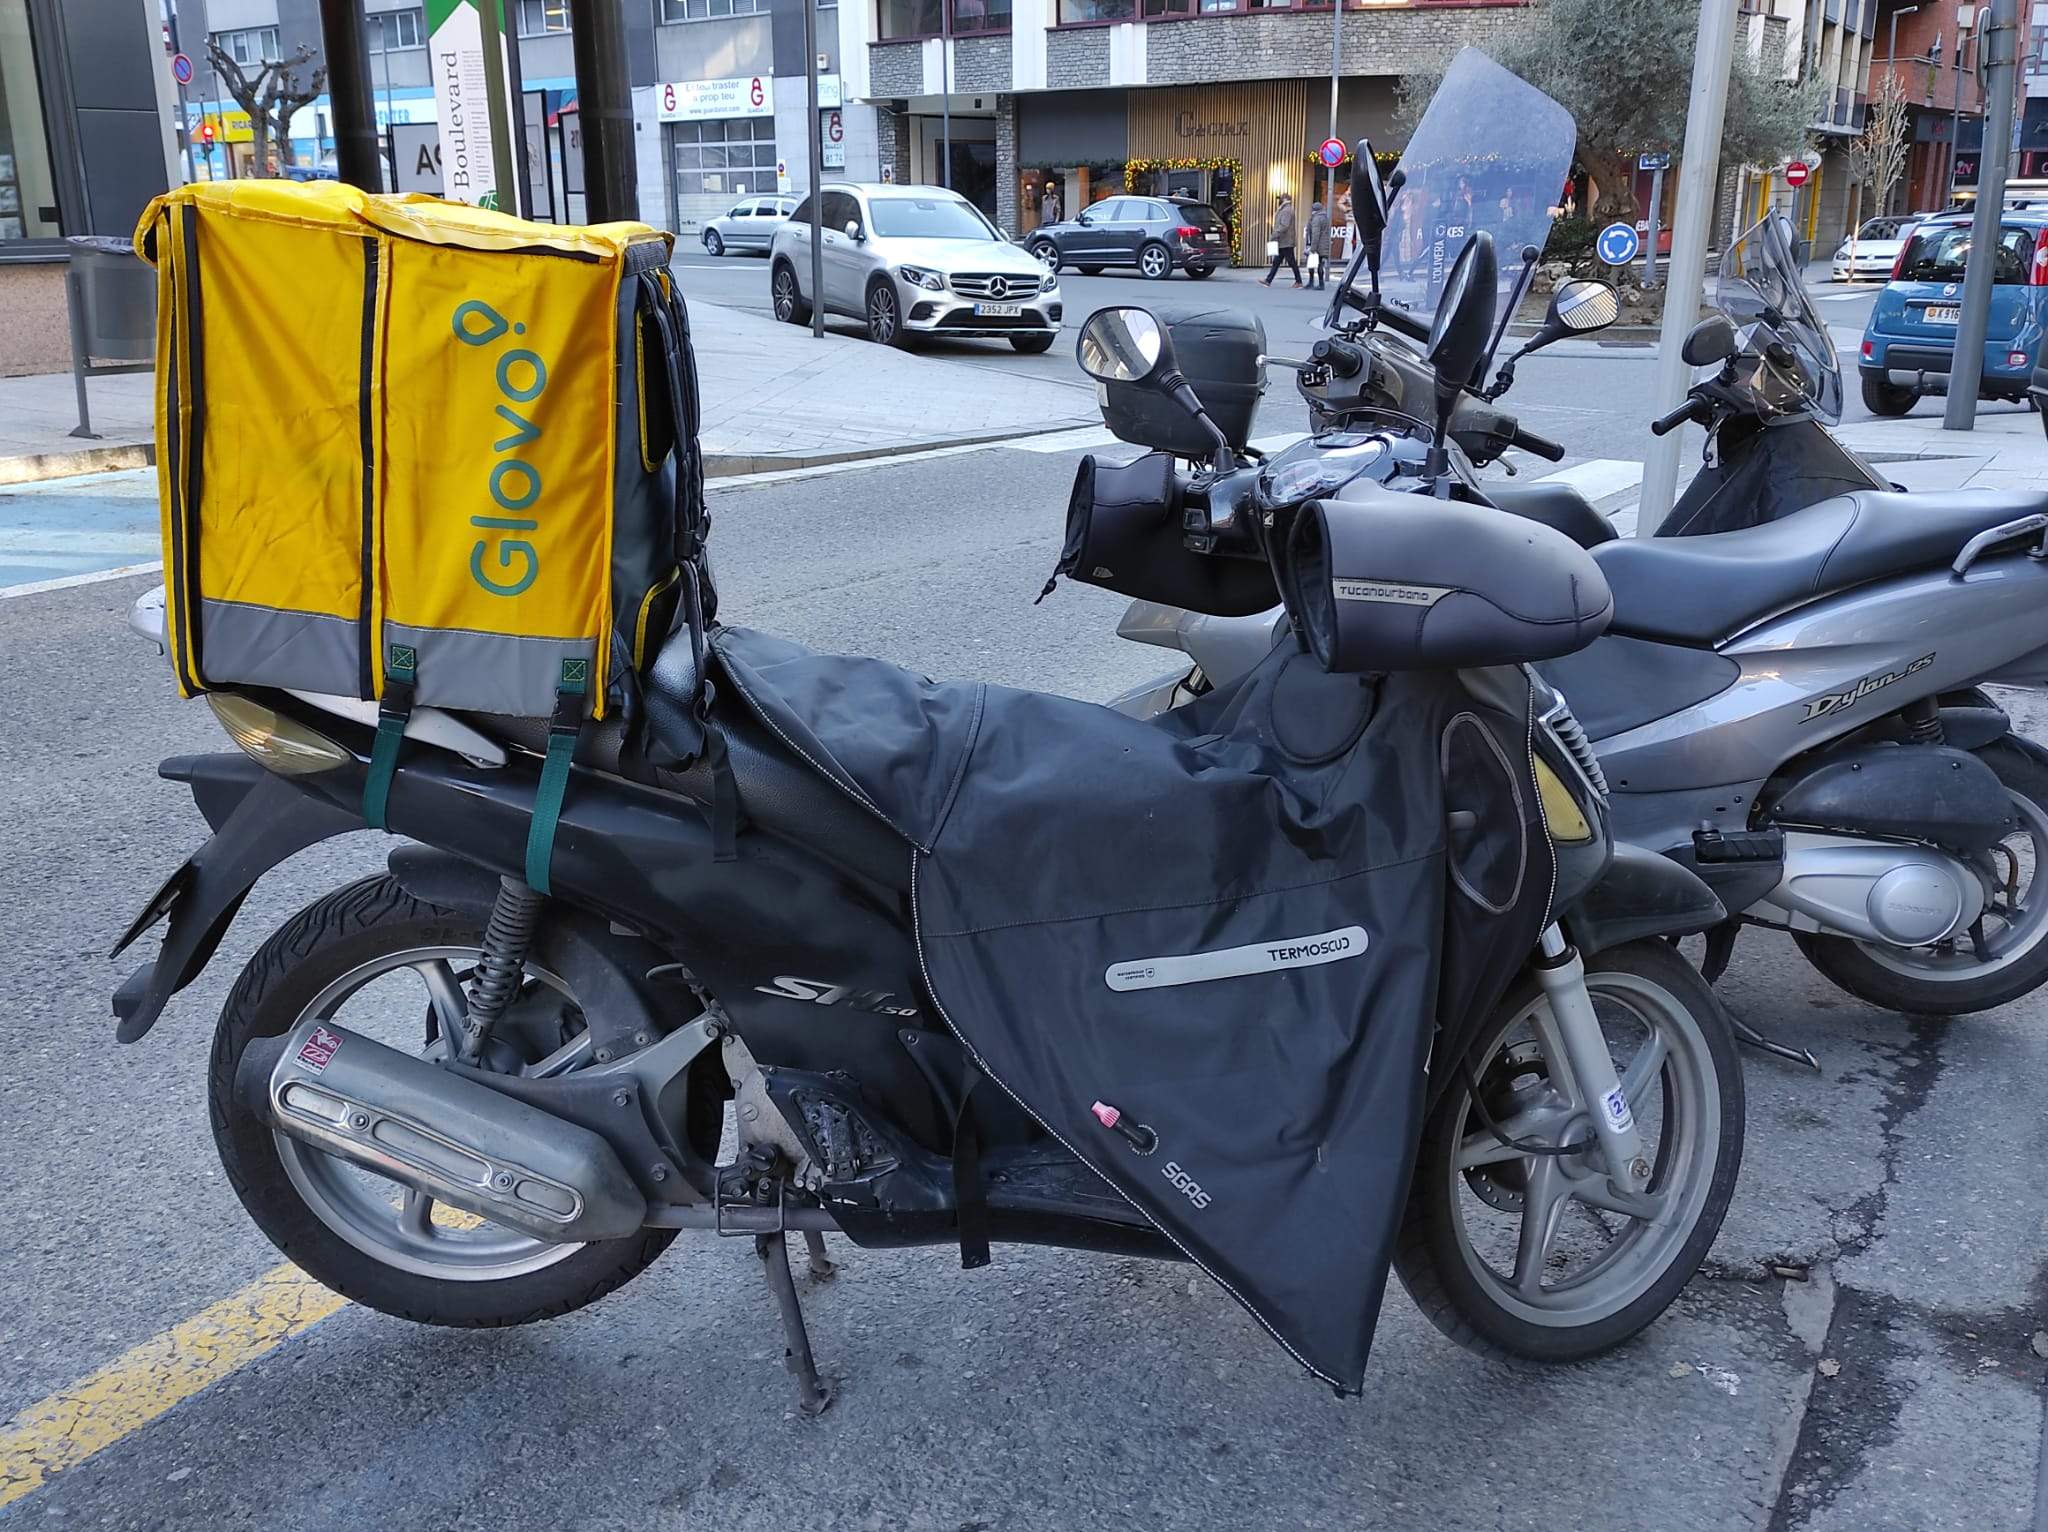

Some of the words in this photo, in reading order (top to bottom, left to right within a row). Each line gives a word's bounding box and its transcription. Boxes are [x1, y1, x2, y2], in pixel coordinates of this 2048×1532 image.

[377, 109, 410, 125] ENTER
[700, 93, 719, 103] prop
[721, 92, 735, 101] teu
[441, 51, 470, 189] Boulevard
[1432, 239, 1445, 283] L'OLIVERA
[981, 304, 1002, 314] 2352
[470, 348, 548, 597] Glovo
[1798, 672, 1906, 724] Dylan
[1267, 937, 1350, 962] TERMOSCUD
[1161, 1161, 1212, 1209] SGAS
